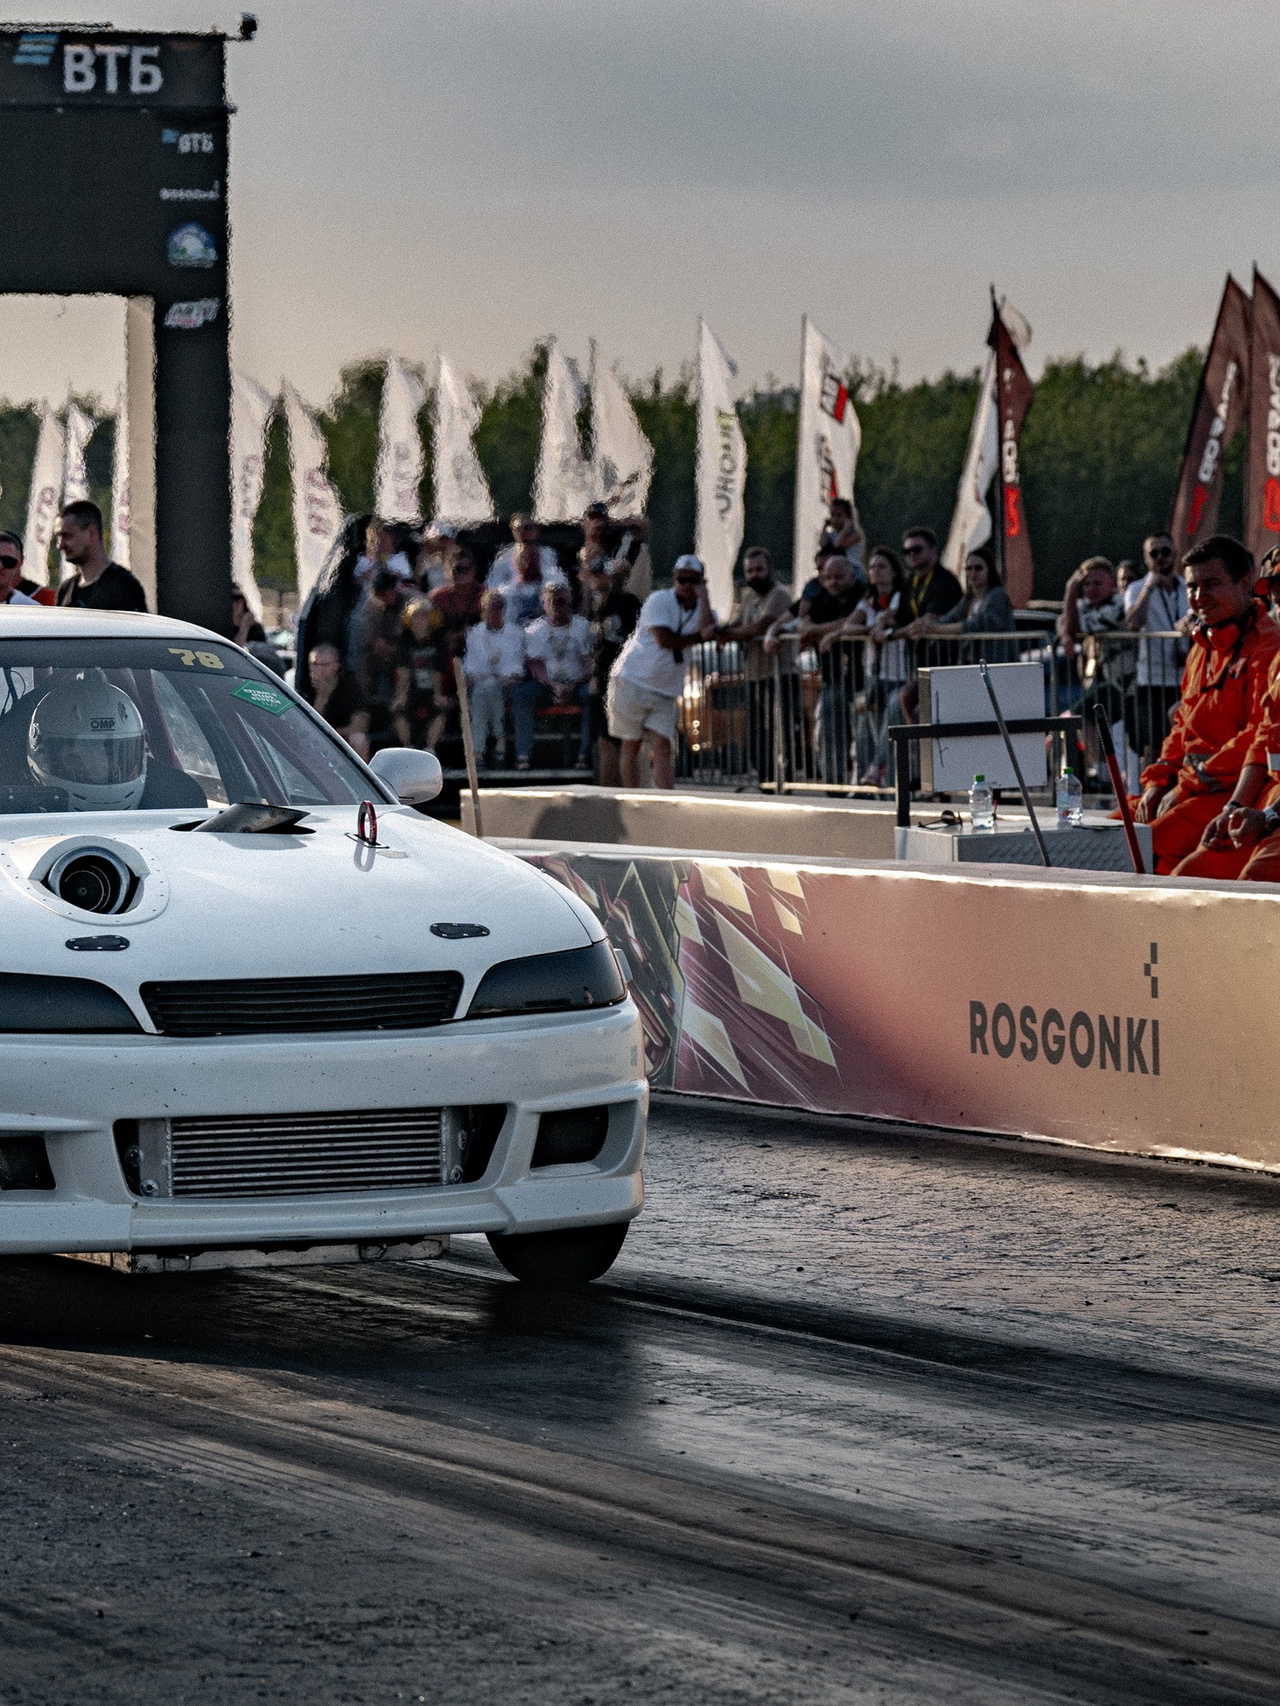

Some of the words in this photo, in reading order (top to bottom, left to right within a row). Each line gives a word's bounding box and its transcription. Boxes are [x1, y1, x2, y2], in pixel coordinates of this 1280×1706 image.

[62, 44, 164, 94] ВТБ
[168, 647, 225, 669] 78
[90, 720, 116, 729] OMP
[970, 1000, 1161, 1076] ROSGONKI
